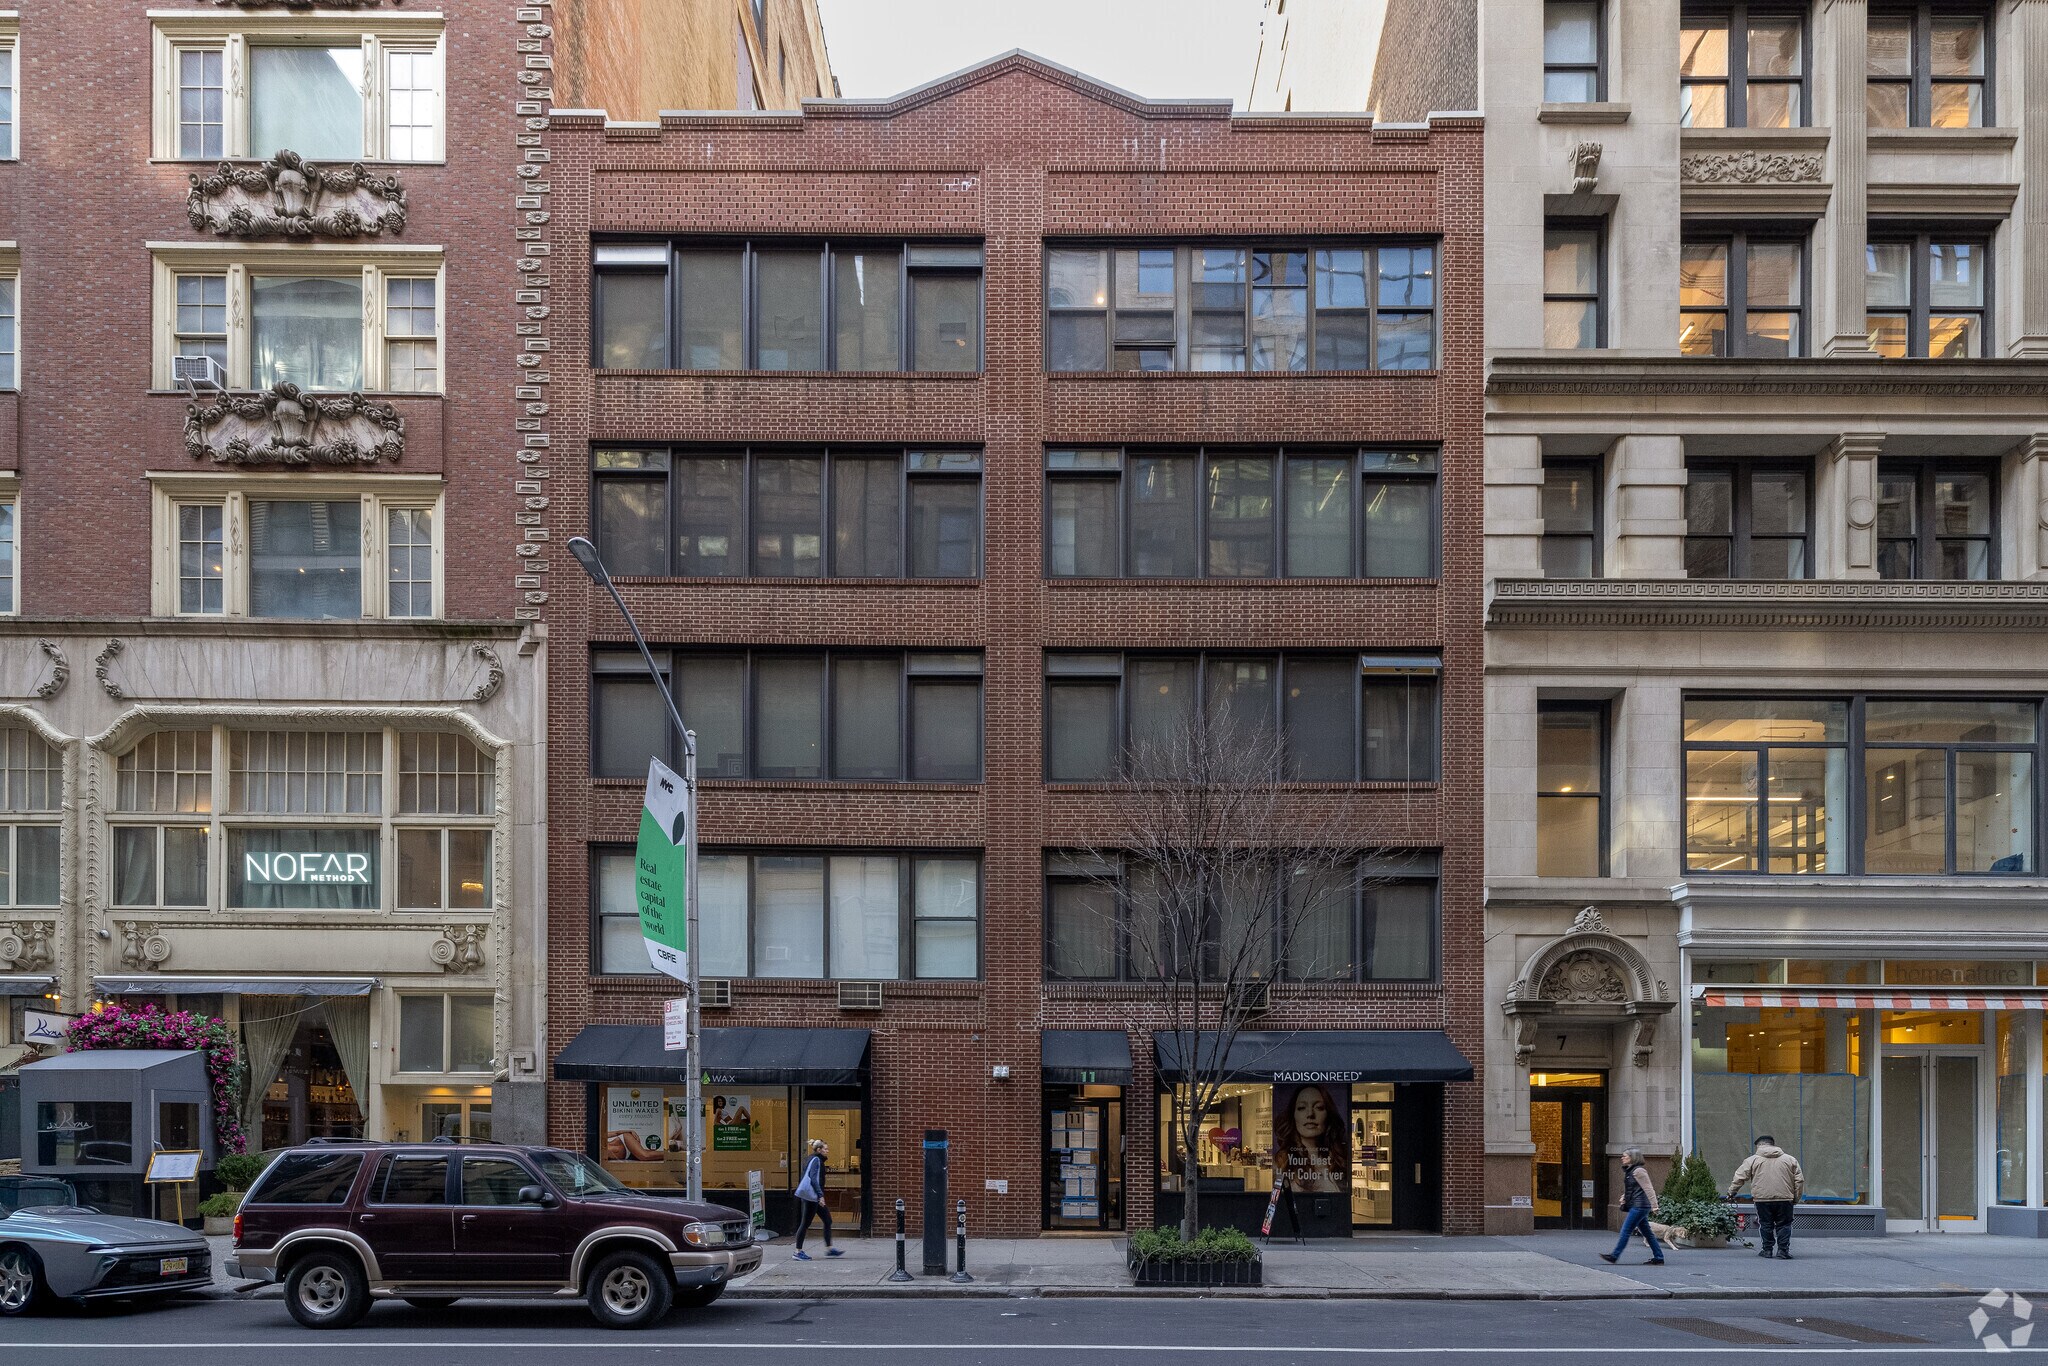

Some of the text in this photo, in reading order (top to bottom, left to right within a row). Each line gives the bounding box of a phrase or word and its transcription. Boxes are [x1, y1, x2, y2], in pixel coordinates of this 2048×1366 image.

[660, 777, 674, 794] NYC
[246, 853, 368, 882] NOFAR
[640, 858, 657, 875] Real
[310, 874, 355, 882] METHOD
[640, 875, 662, 892] estate
[640, 890, 666, 908] capital
[642, 904, 663, 921] of the
[644, 920, 665, 935] world
[657, 948, 677, 964] CBRE
[1896, 960, 2018, 983] homenature
[666, 1002, 671, 1012] 3
[1556, 1034, 1567, 1051] 7
[712, 1074, 736, 1083] WAX
[1080, 1071, 1096, 1083] 11
[612, 1100, 659, 1108] UNLIMITED
[1069, 1113, 1081, 1124] 11
[1287, 1153, 1332, 1166] Your Best
[1297, 1168, 1320, 1180] Color
[1324, 1168, 1344, 1180] Ever
